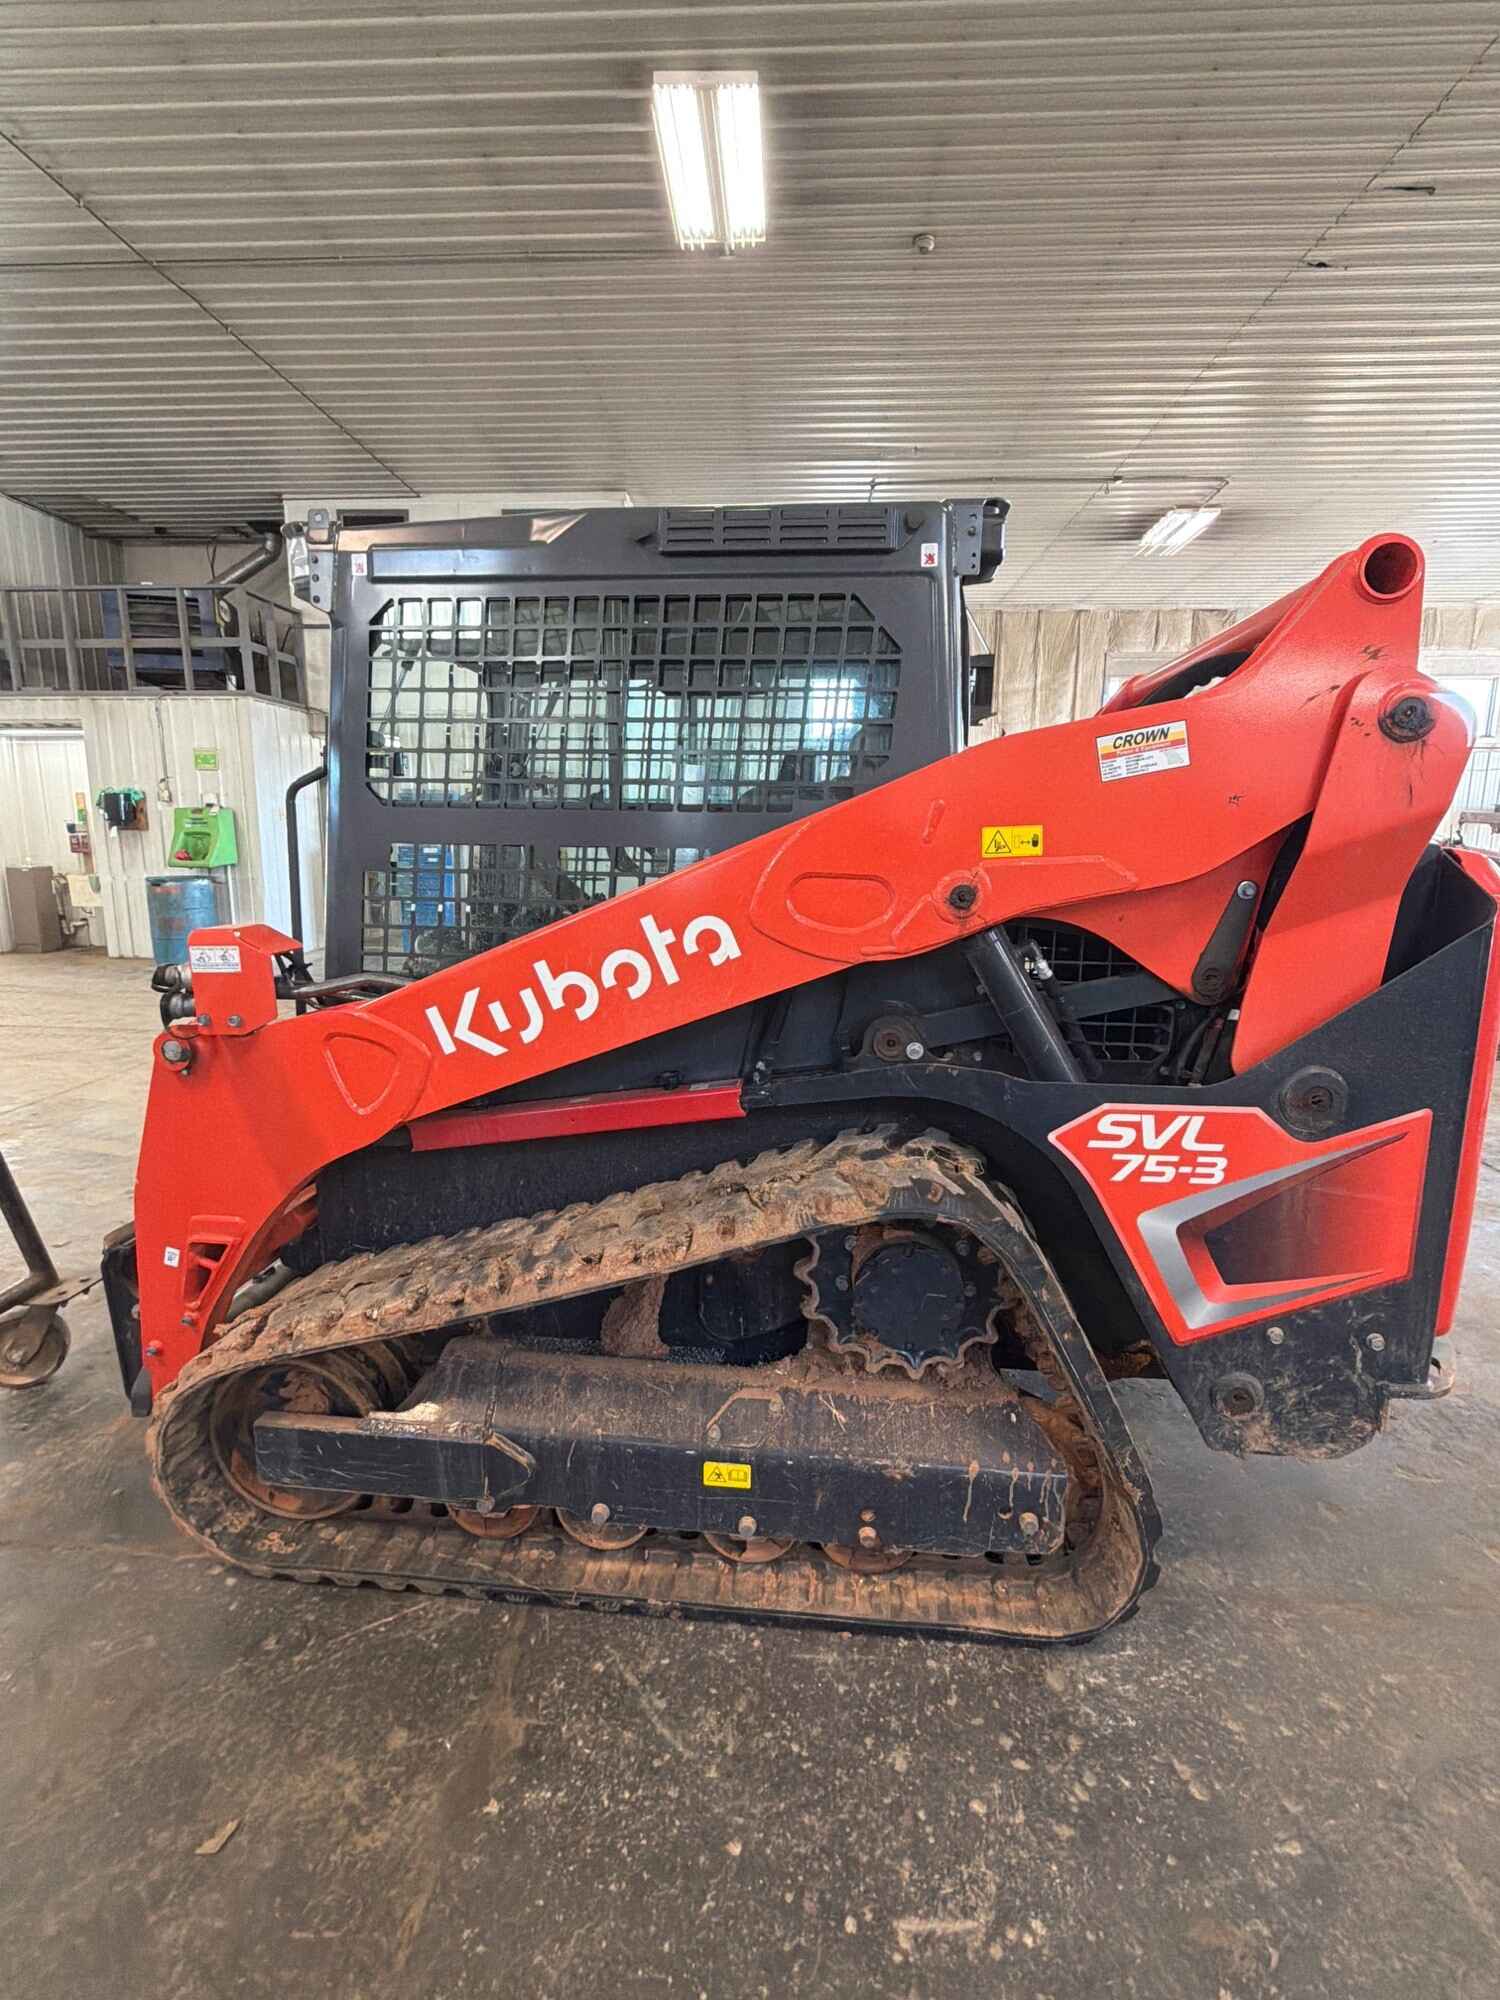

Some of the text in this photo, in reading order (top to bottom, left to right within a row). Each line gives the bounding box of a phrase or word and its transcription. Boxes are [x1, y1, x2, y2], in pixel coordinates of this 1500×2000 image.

[1113, 727, 1170, 749] CROWN
[425, 914, 742, 1056] Kubota
[1087, 1113, 1225, 1152] SVL
[1109, 1154, 1228, 1185] 75-3
